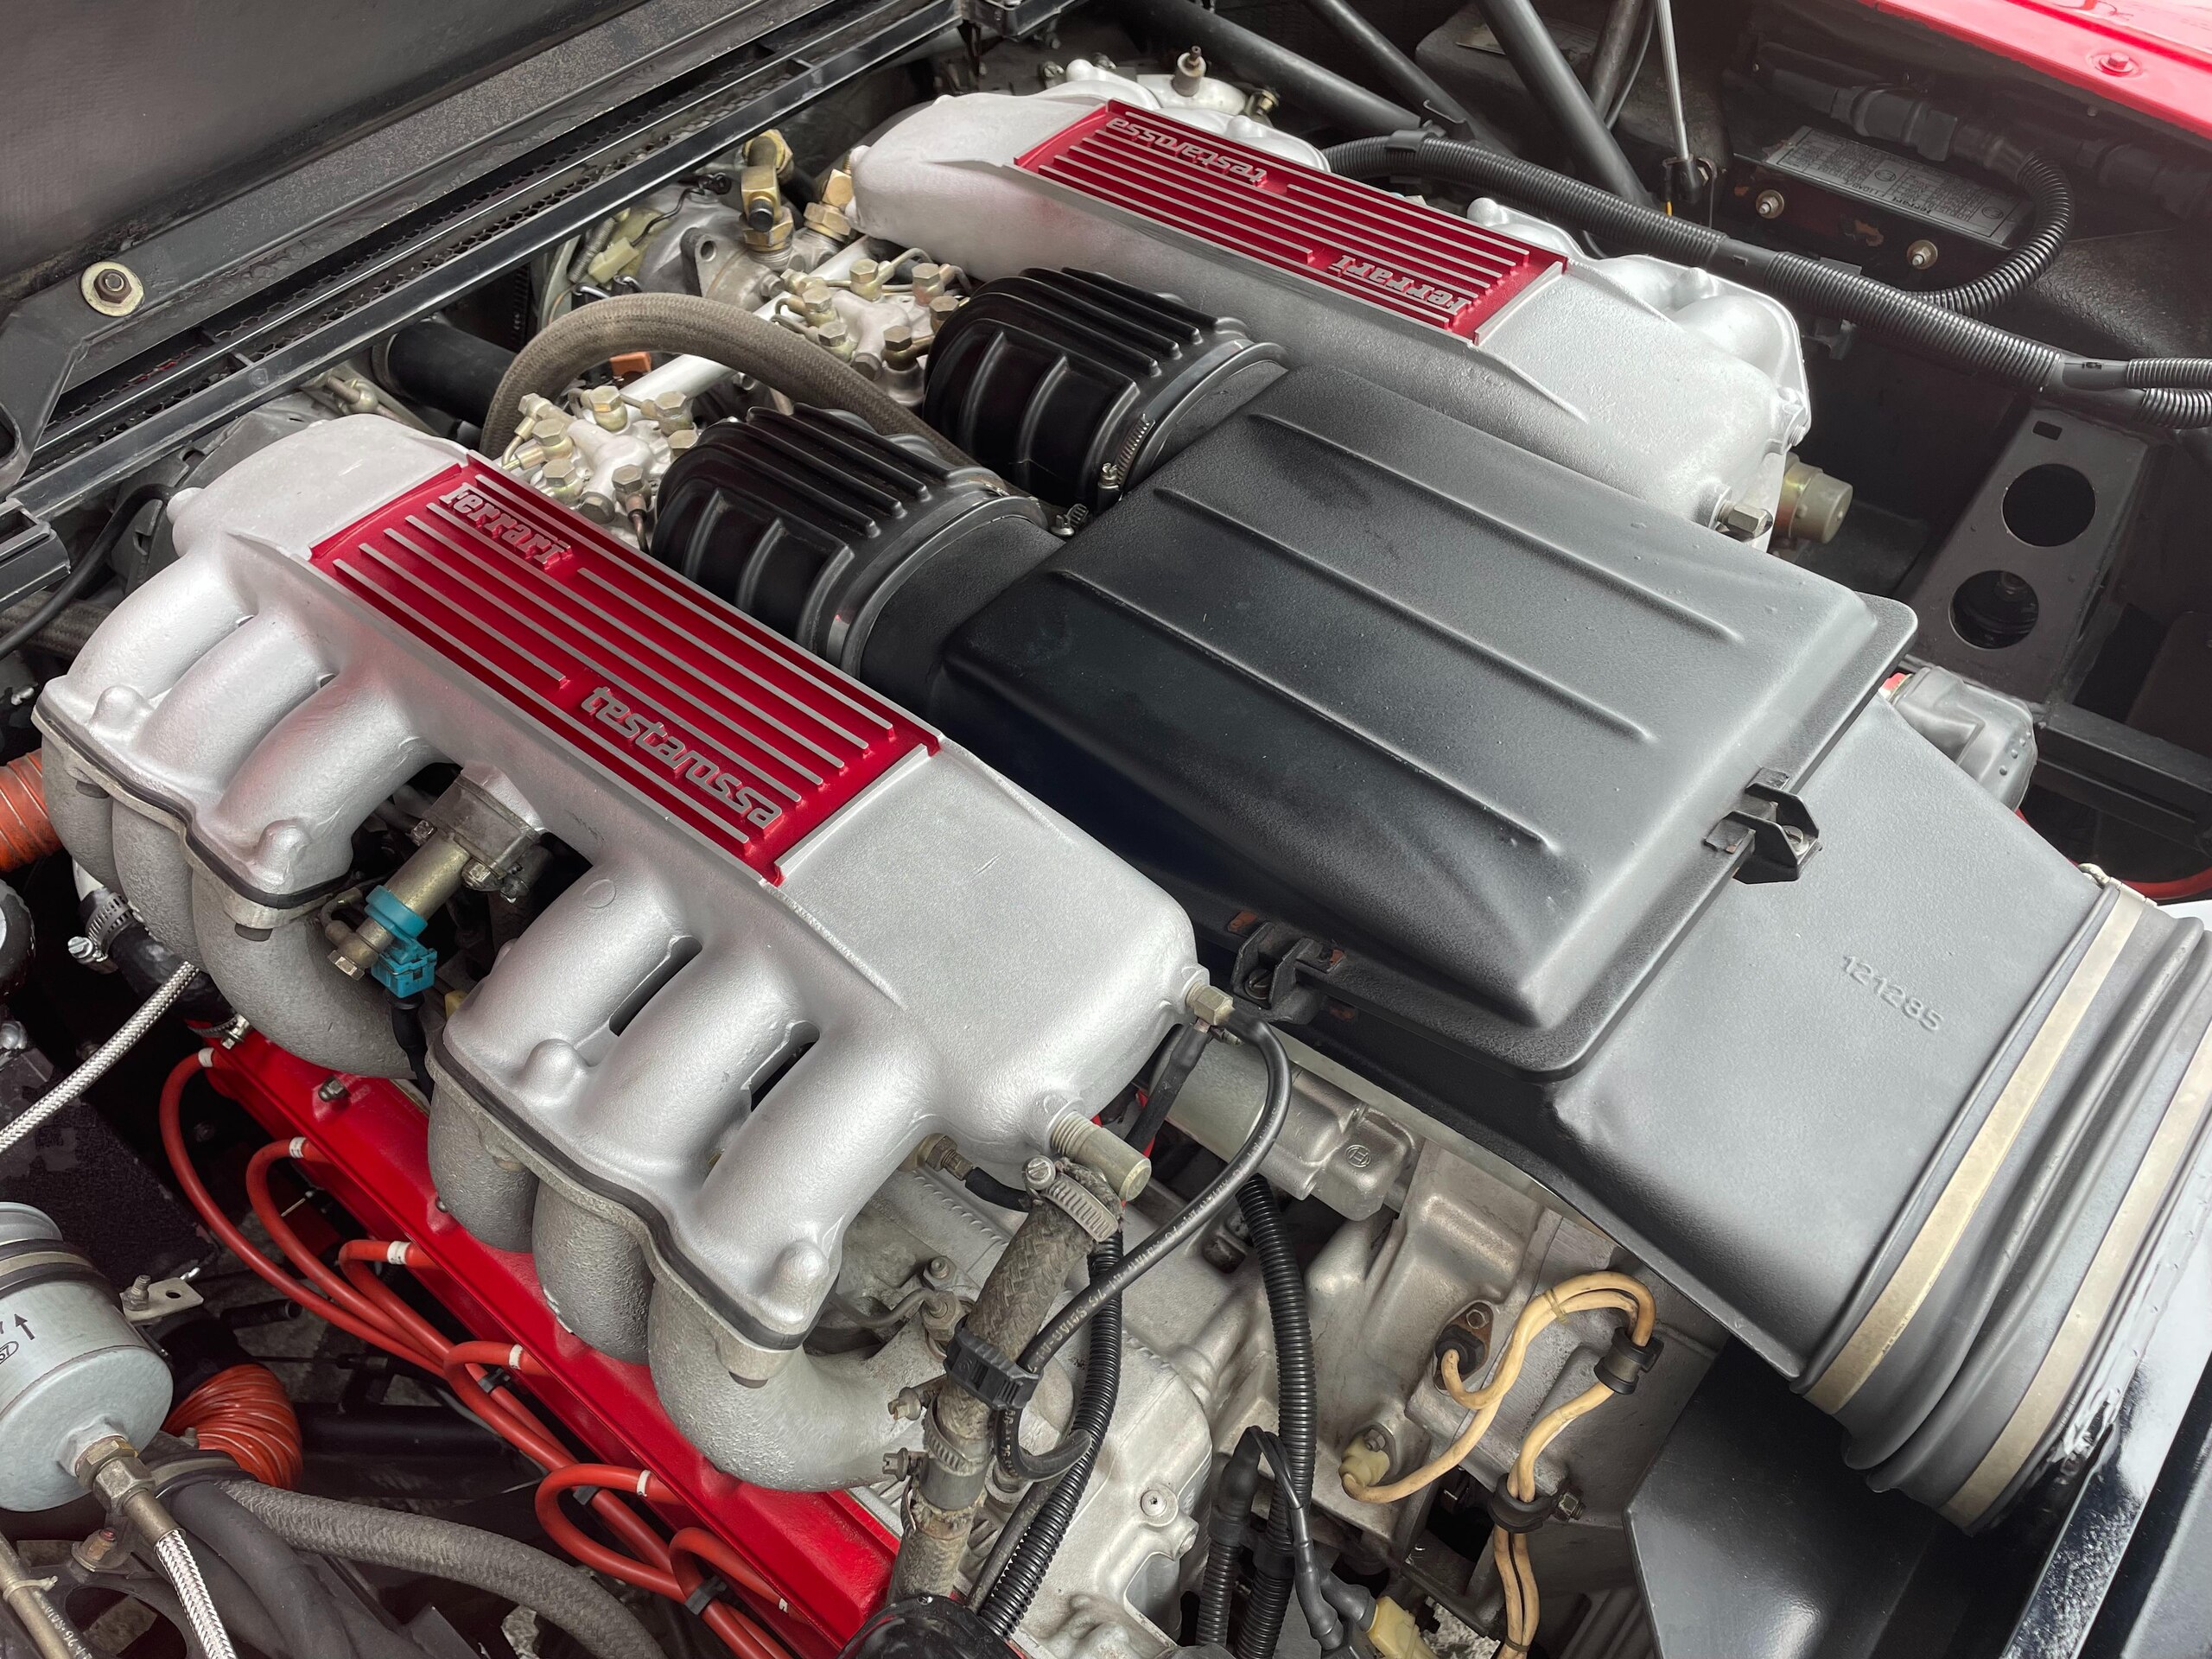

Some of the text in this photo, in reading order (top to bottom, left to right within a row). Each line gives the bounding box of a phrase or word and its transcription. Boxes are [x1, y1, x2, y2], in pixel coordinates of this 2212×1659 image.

[1106, 118, 1268, 182] testarossa
[1327, 255, 1472, 315] Ferrari
[439, 482, 571, 567] Ferrari
[581, 686, 783, 830] testarossa
[1842, 955, 1944, 1032] 121285
